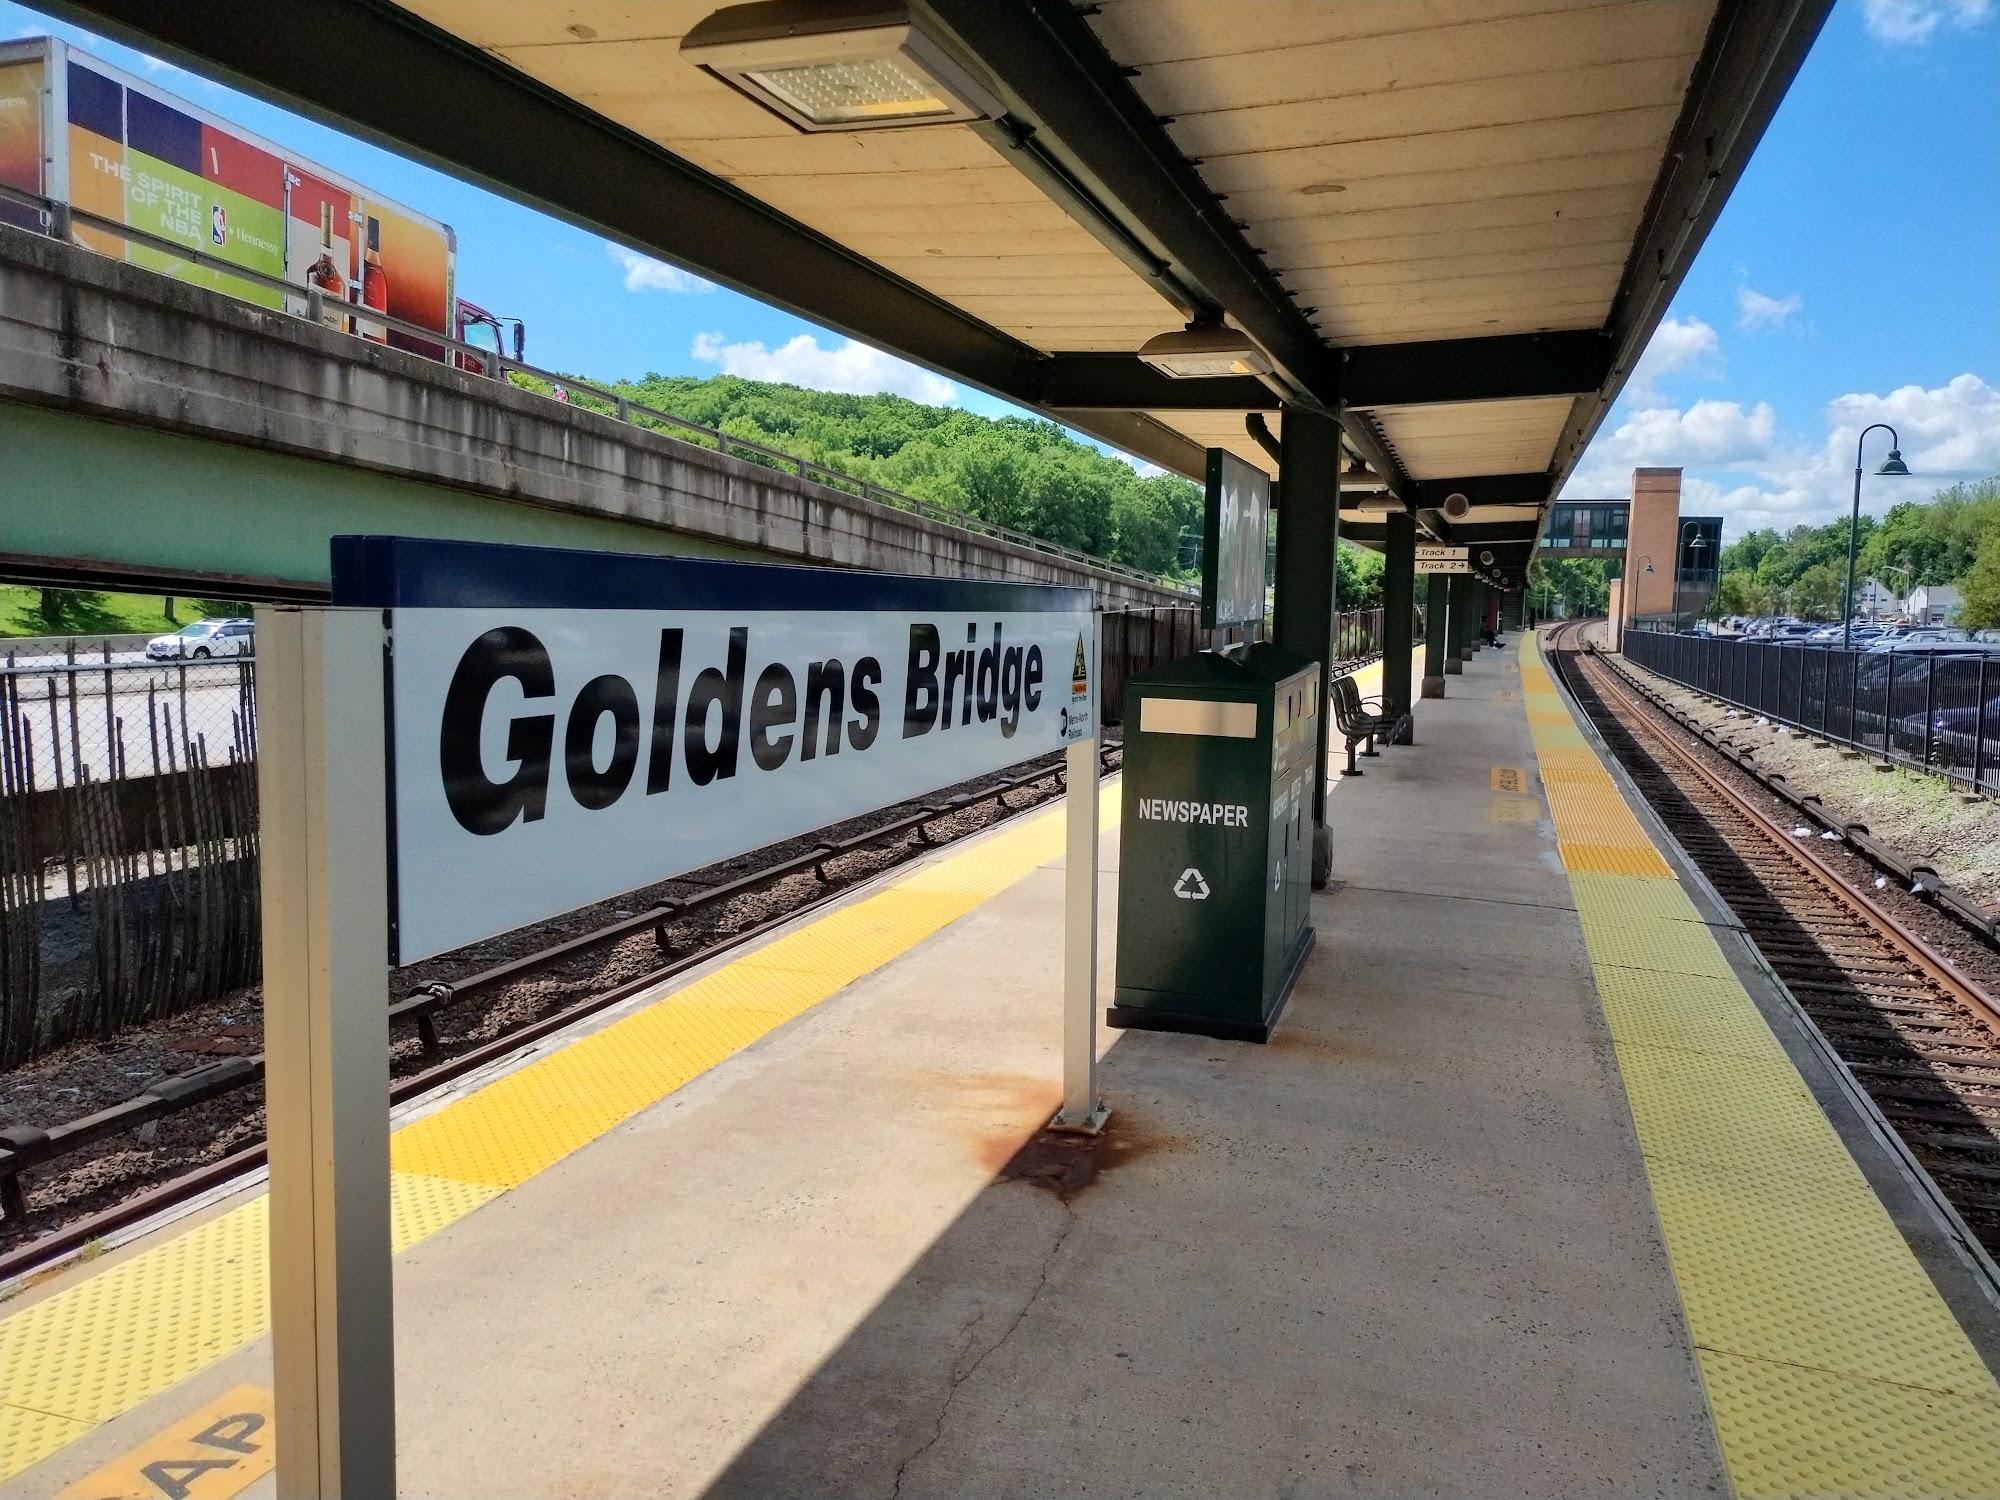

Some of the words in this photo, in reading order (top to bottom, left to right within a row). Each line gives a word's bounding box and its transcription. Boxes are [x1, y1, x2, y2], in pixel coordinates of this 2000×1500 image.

[89, 152, 132, 182] THE
[137, 172, 202, 208] SPIRIT
[130, 186, 158, 206] OF
[163, 198, 202, 225] THE
[160, 213, 202, 240] NBA
[236, 227, 280, 256] Hennessy
[440, 625, 882, 836] Goldens
[902, 622, 1043, 740] Bridge
[1138, 798, 1249, 828] NEWSPAPER
[100, 1413, 265, 1500] AP
